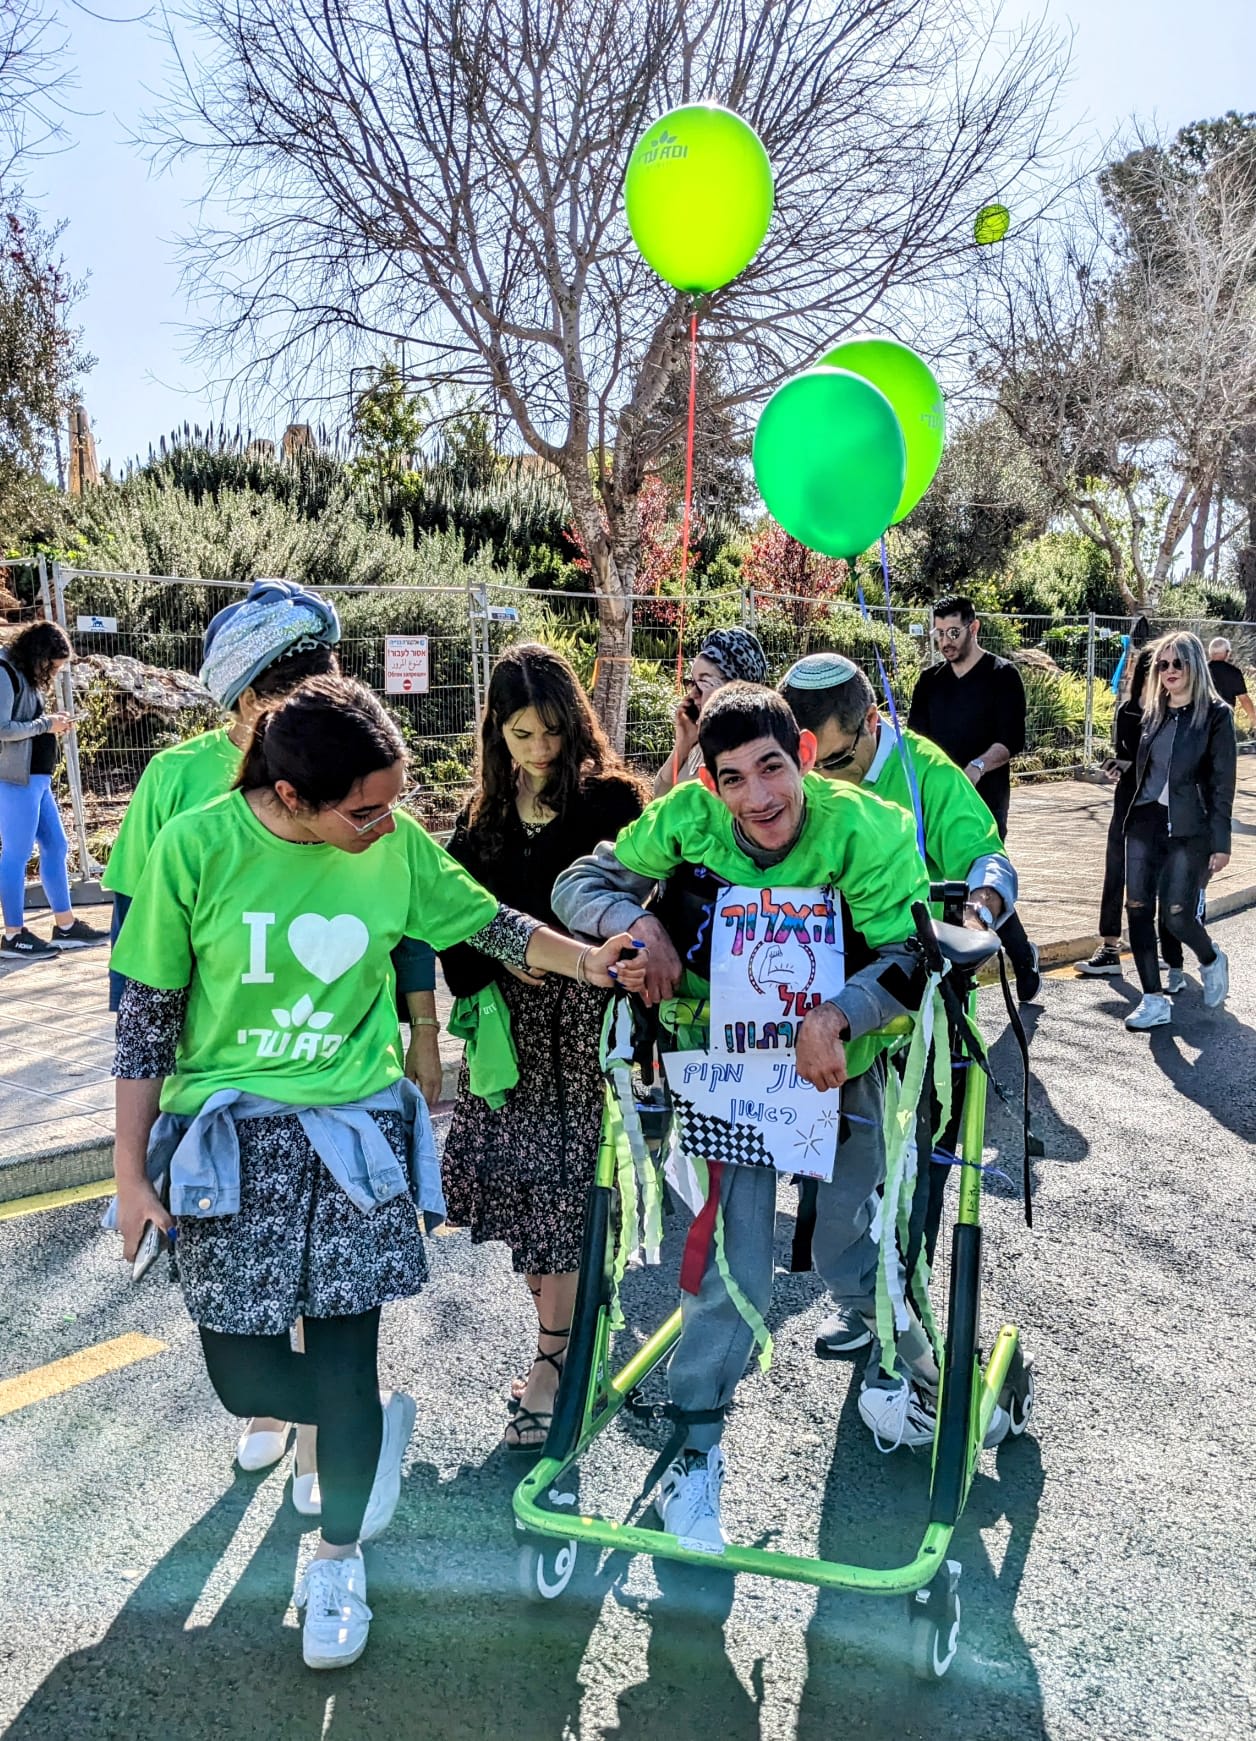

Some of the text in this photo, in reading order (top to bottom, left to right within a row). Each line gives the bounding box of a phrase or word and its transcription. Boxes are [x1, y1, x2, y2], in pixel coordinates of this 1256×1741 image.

[410, 649, 426, 657] אסור
[720, 888, 835, 956] האלוף
[241, 911, 276, 985] I
[778, 984, 821, 1017] של
[290, 1031, 349, 1062] AD
[683, 1062, 744, 1093] מקום
[730, 1099, 797, 1131] ראשון
